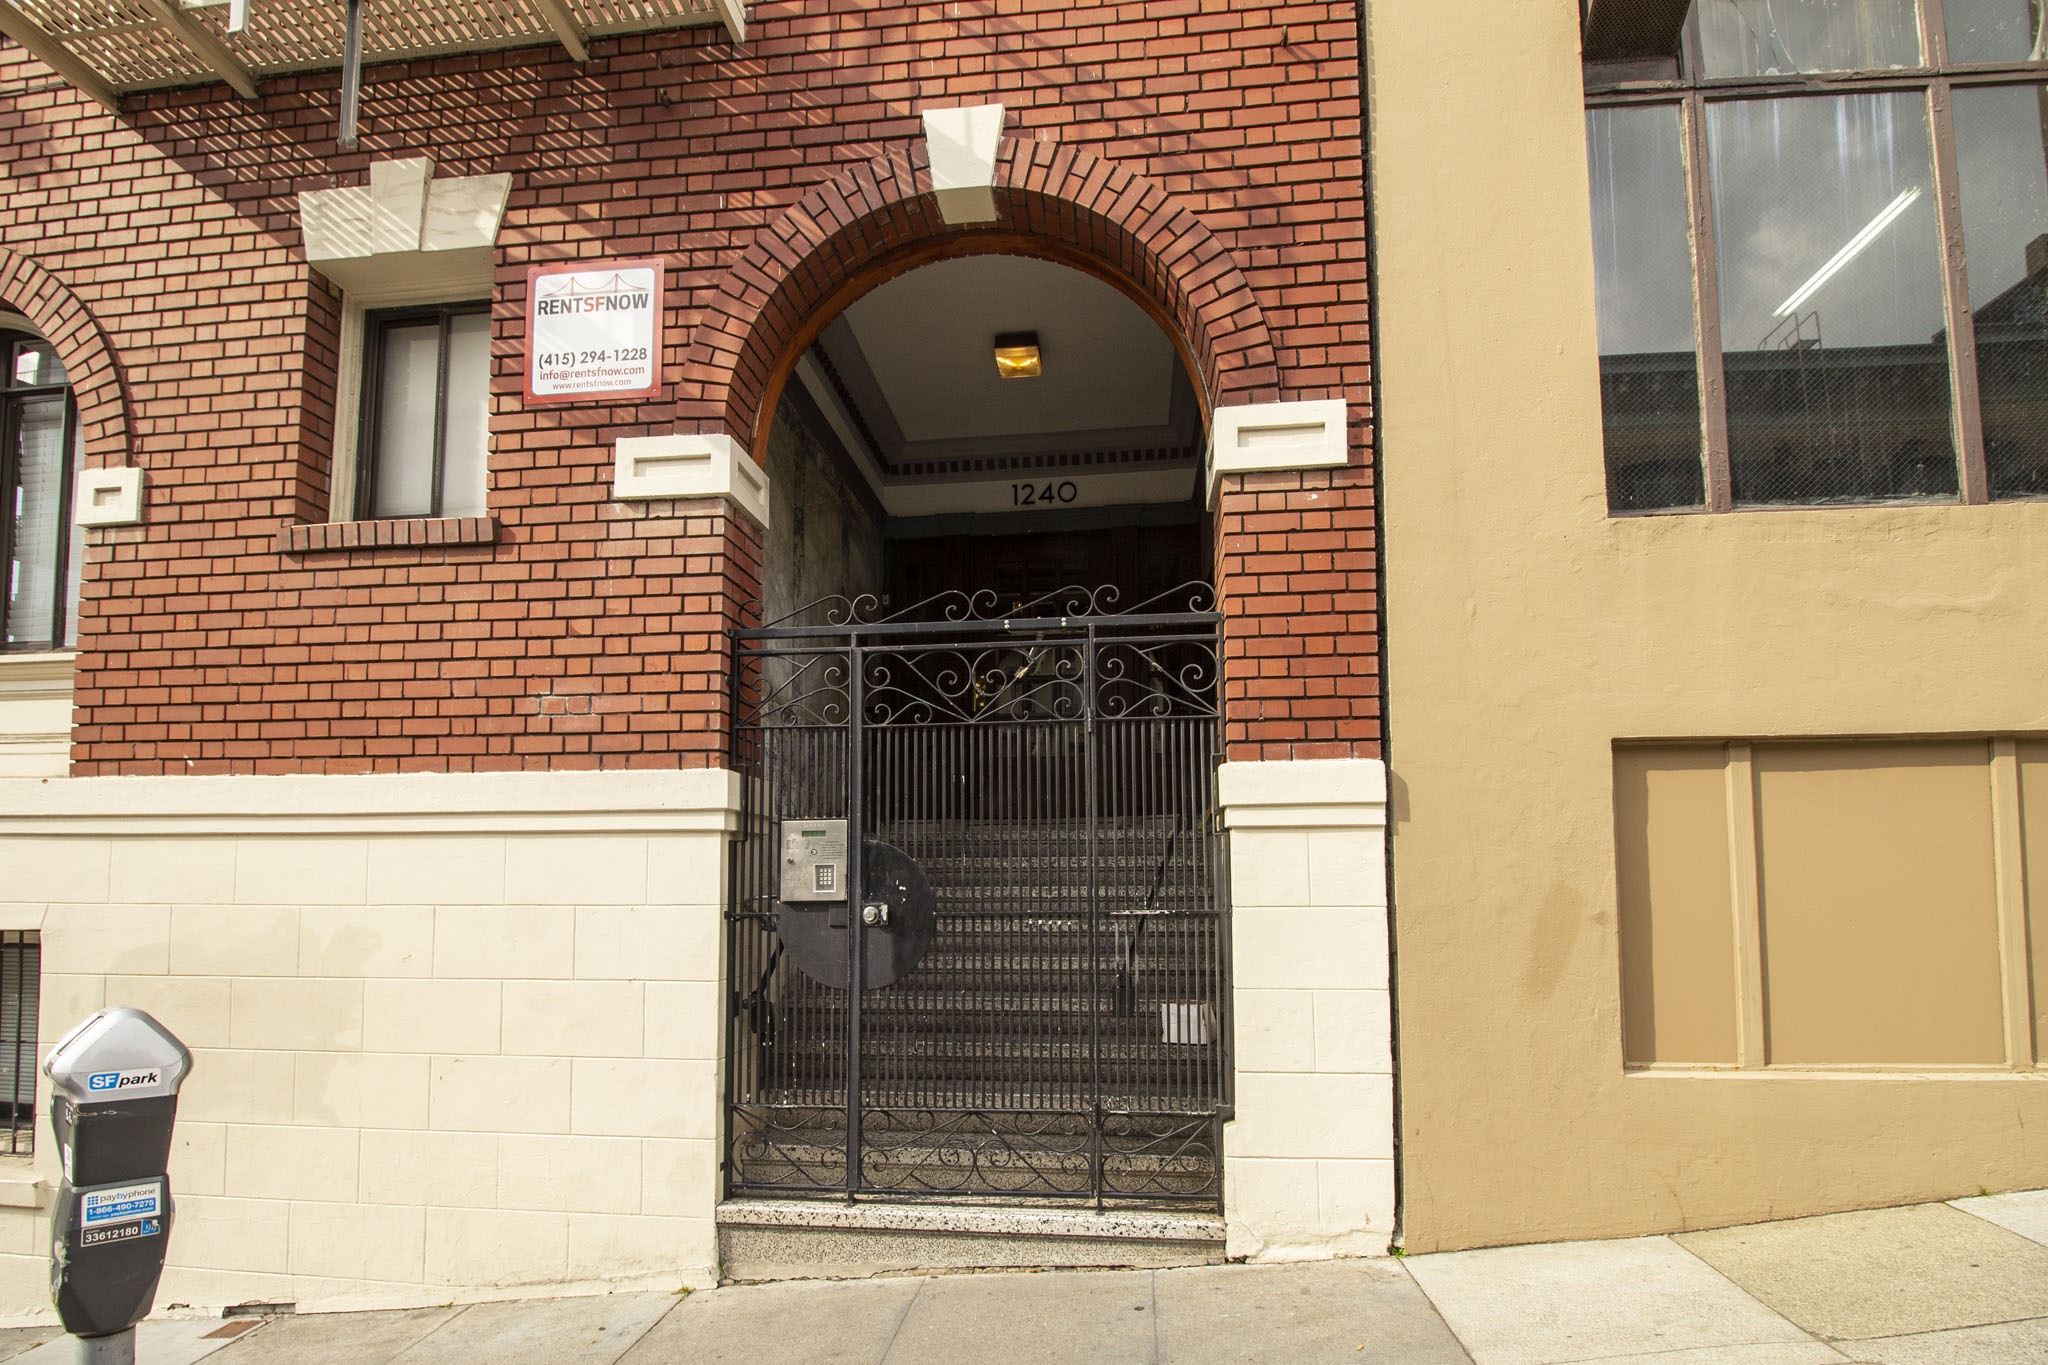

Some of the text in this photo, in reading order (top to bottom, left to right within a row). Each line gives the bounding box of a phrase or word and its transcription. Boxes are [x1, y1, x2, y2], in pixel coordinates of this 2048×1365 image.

[538, 293, 649, 316] RENTSFNOW
[539, 348, 648, 370] (415) 294-1228
[540, 366, 645, 381] info@rentsfnow.com
[552, 378, 632, 390] www.rentsfnow.com
[1012, 481, 1078, 506] 1240
[100, 1188, 156, 1204] paybyphone
[88, 1200, 154, 1216] 1-866-490-7275
[85, 1226, 139, 1243] 33612180
